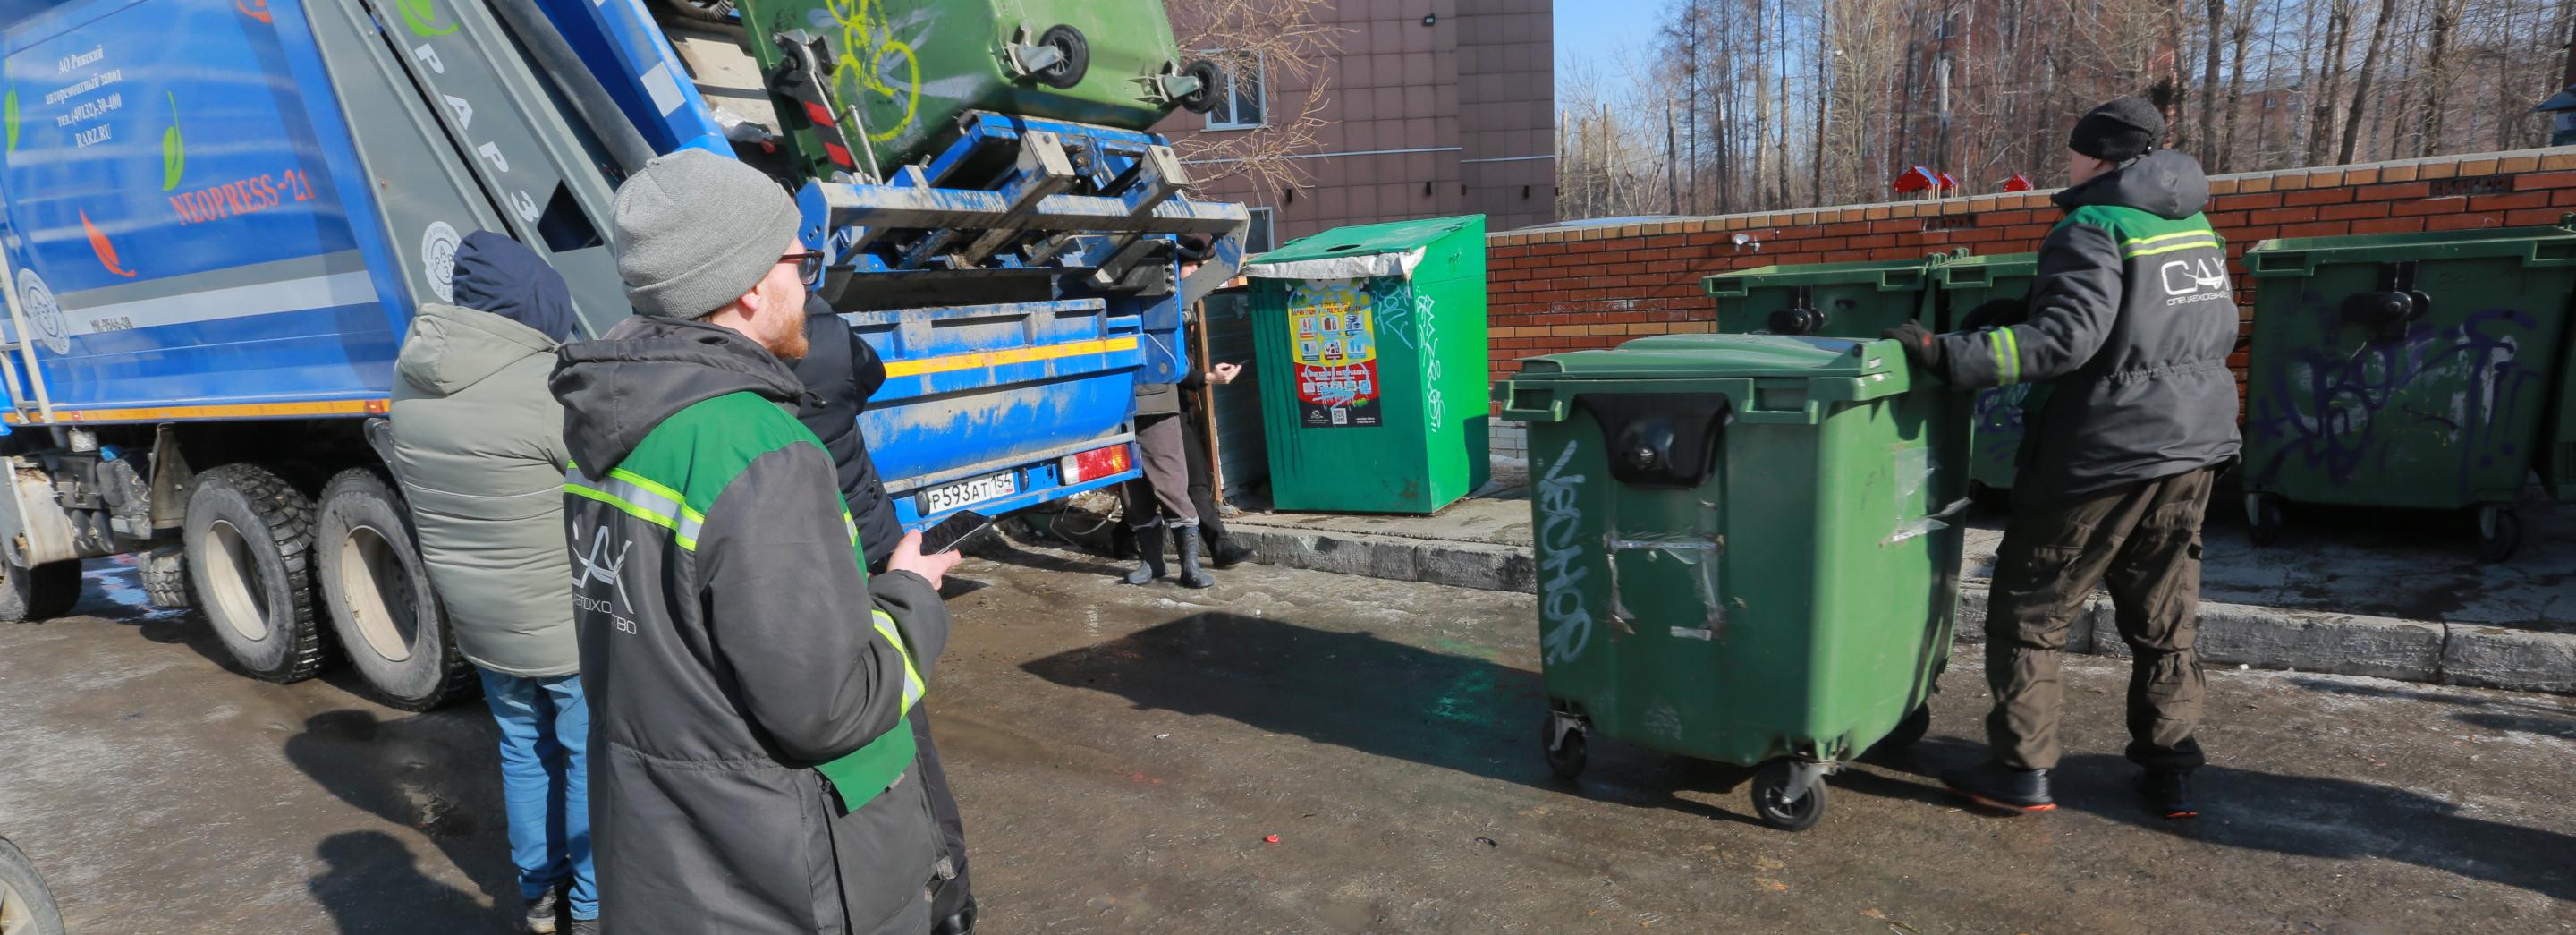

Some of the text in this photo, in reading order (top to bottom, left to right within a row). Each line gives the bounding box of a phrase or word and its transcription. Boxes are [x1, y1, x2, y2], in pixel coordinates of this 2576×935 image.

[75, 124, 112, 148] RARZ.RU
[932, 472, 1011, 509] Р593АТ 154
